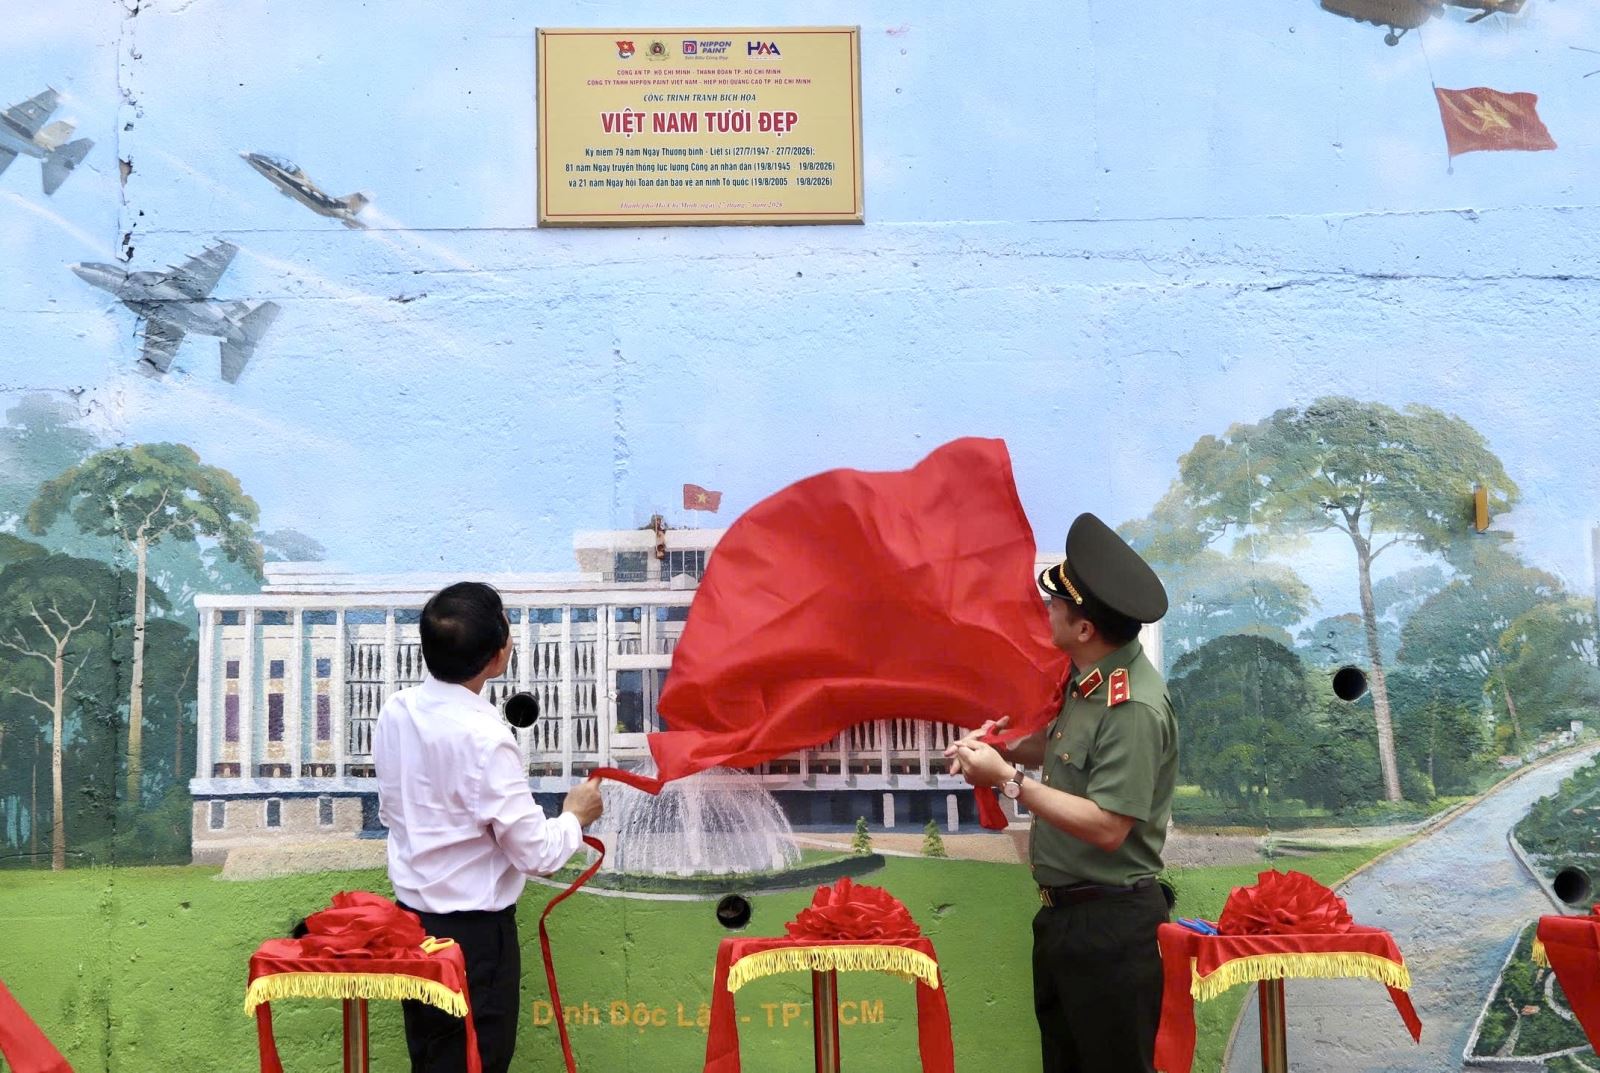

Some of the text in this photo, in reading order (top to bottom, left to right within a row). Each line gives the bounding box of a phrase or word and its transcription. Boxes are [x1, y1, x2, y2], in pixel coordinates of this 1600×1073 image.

[699, 40, 732, 49] NIPPON
[747, 41, 781, 56] HAA
[692, 93, 718, 103] TRANH
[601, 108, 798, 138] VIỆT NAM TƯƠI ĐẸP
[615, 147, 624, 157] 79
[565, 163, 574, 172] 81
[709, 163, 719, 172] an
[799, 161, 835, 171] 19/8/2026)
[578, 178, 587, 187] 21
[694, 178, 704, 187] an
[705, 178, 721, 187] ninh
[796, 176, 833, 186] 19/8/2026)
[532, 1000, 599, 1026] Dnh
[609, 999, 667, 1034] Độc
[761, 999, 885, 1029] TP.CM
